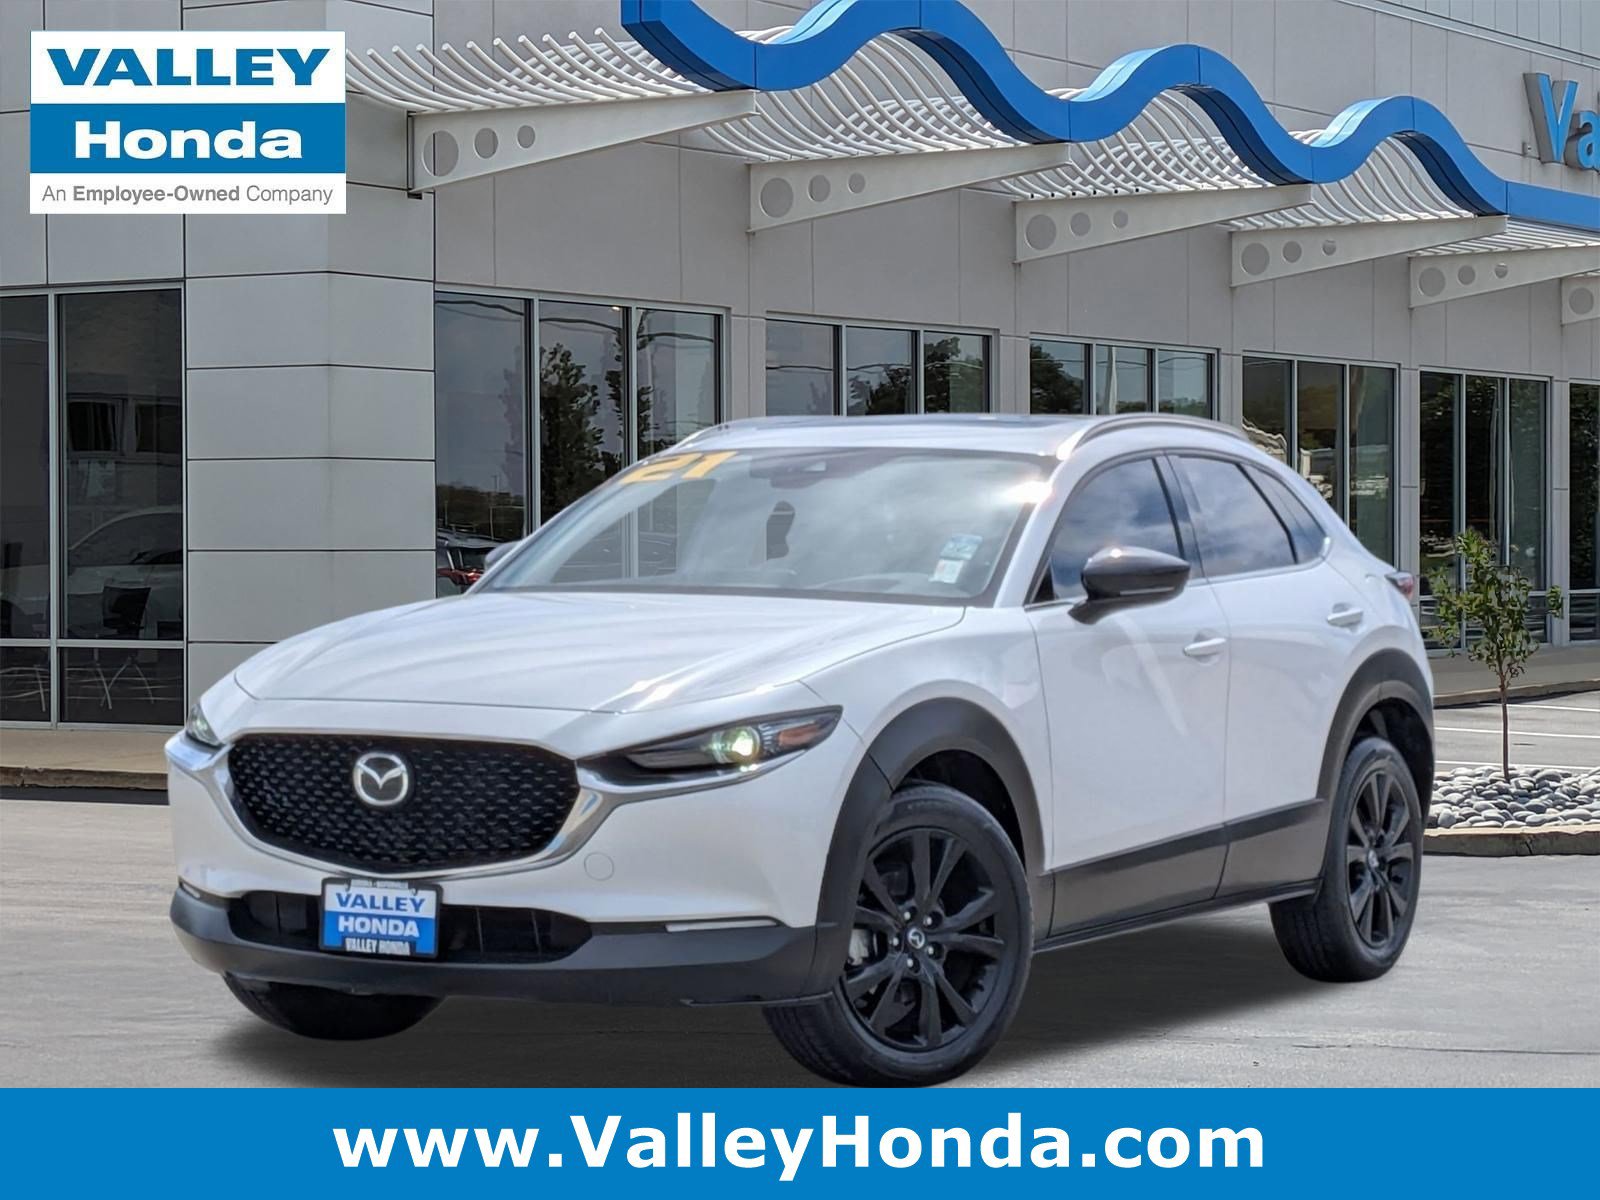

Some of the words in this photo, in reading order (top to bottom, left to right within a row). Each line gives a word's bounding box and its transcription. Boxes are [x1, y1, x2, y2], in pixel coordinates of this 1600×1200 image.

[336, 892, 426, 913] VALLEY
[338, 916, 419, 937] HONDA
[345, 937, 377, 954] VALLEY
